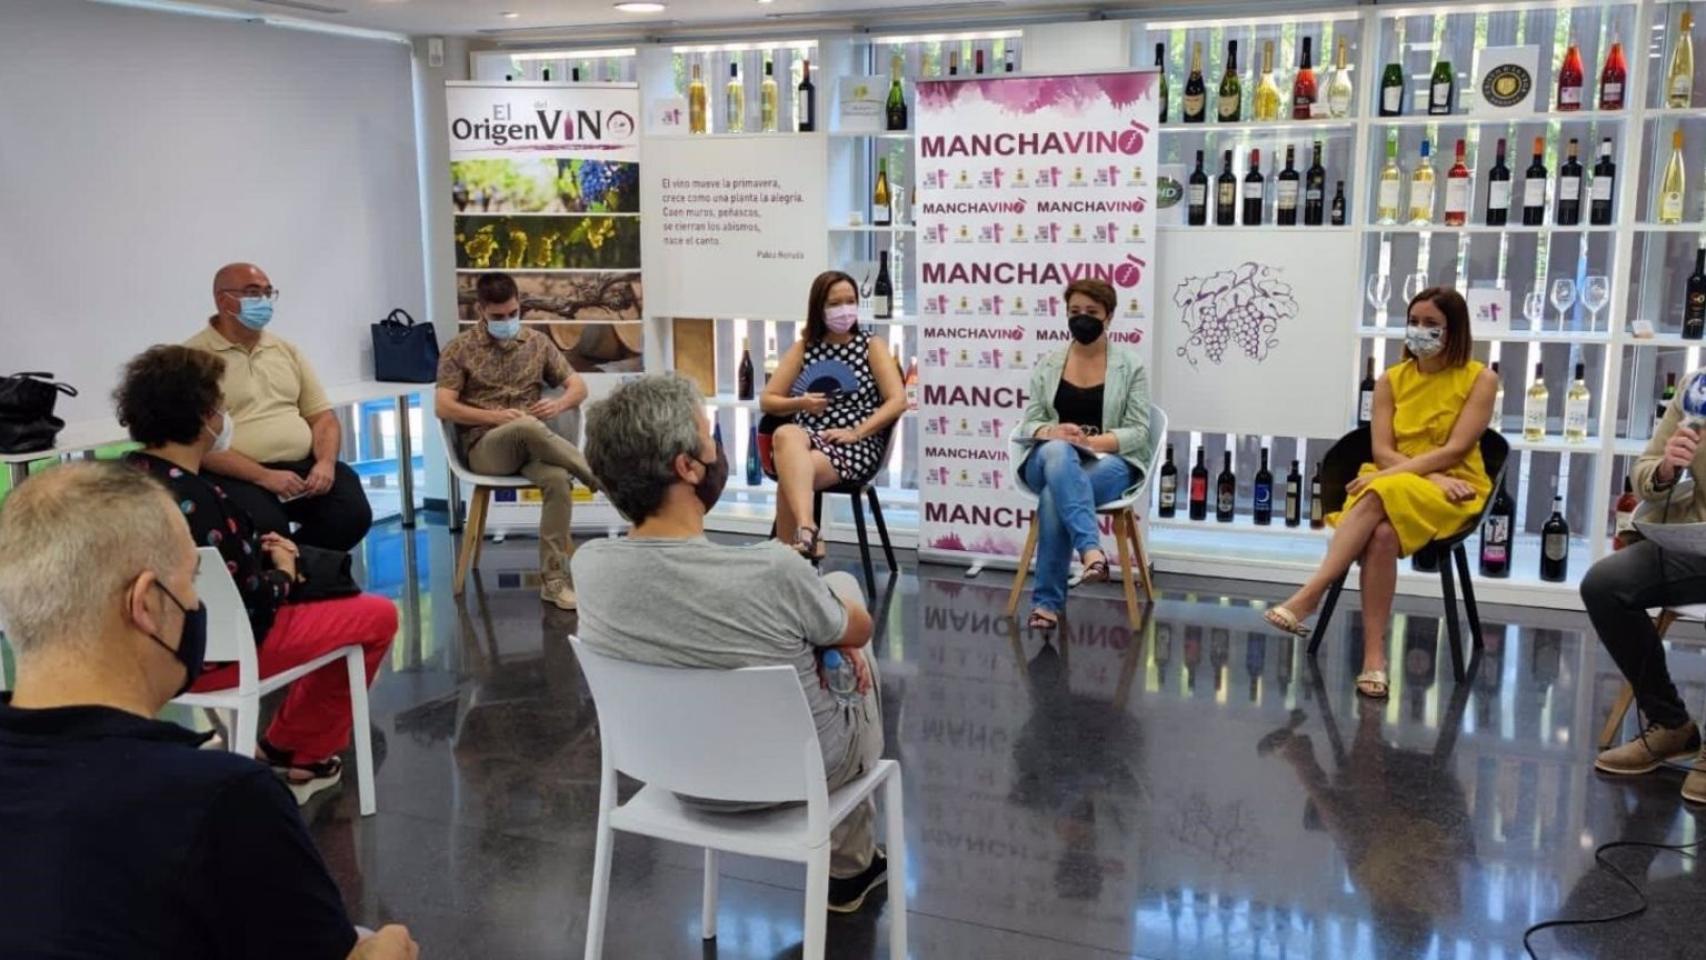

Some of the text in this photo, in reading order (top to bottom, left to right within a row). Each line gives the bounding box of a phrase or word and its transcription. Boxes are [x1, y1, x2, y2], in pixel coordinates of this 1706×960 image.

[492, 103, 511, 121] El
[452, 118, 538, 146] Origen
[661, 177, 781, 192] El vino mueve la primavera,
[662, 194, 685, 203] crece
[688, 194, 710, 203] como
[713, 194, 729, 203] una
[731, 192, 758, 205] planta
[760, 192, 769, 203] la
[663, 222, 672, 232] se
[675, 220, 706, 232] cierran
[707, 221, 721, 232] los
[924, 384, 1030, 409] MANCH
[925, 446, 1010, 461] MANCHAVIN
